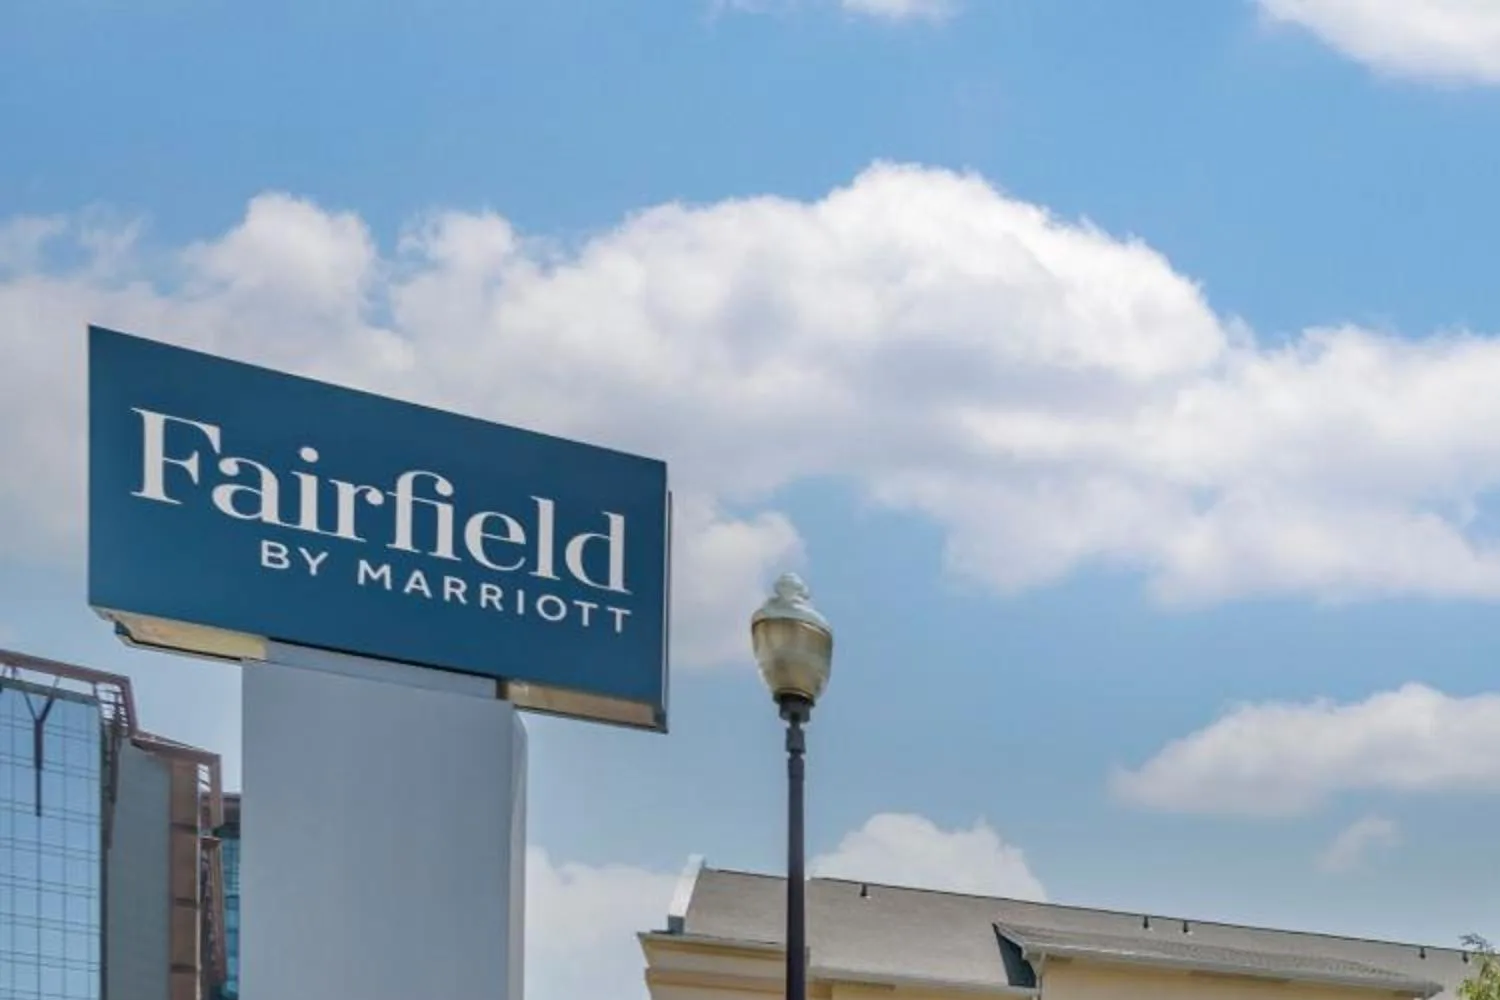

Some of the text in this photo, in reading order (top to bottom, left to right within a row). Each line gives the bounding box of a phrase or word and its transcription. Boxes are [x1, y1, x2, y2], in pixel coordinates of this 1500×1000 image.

[130, 407, 631, 594] Fairfield
[260, 540, 631, 633] BY MARRIOTT
